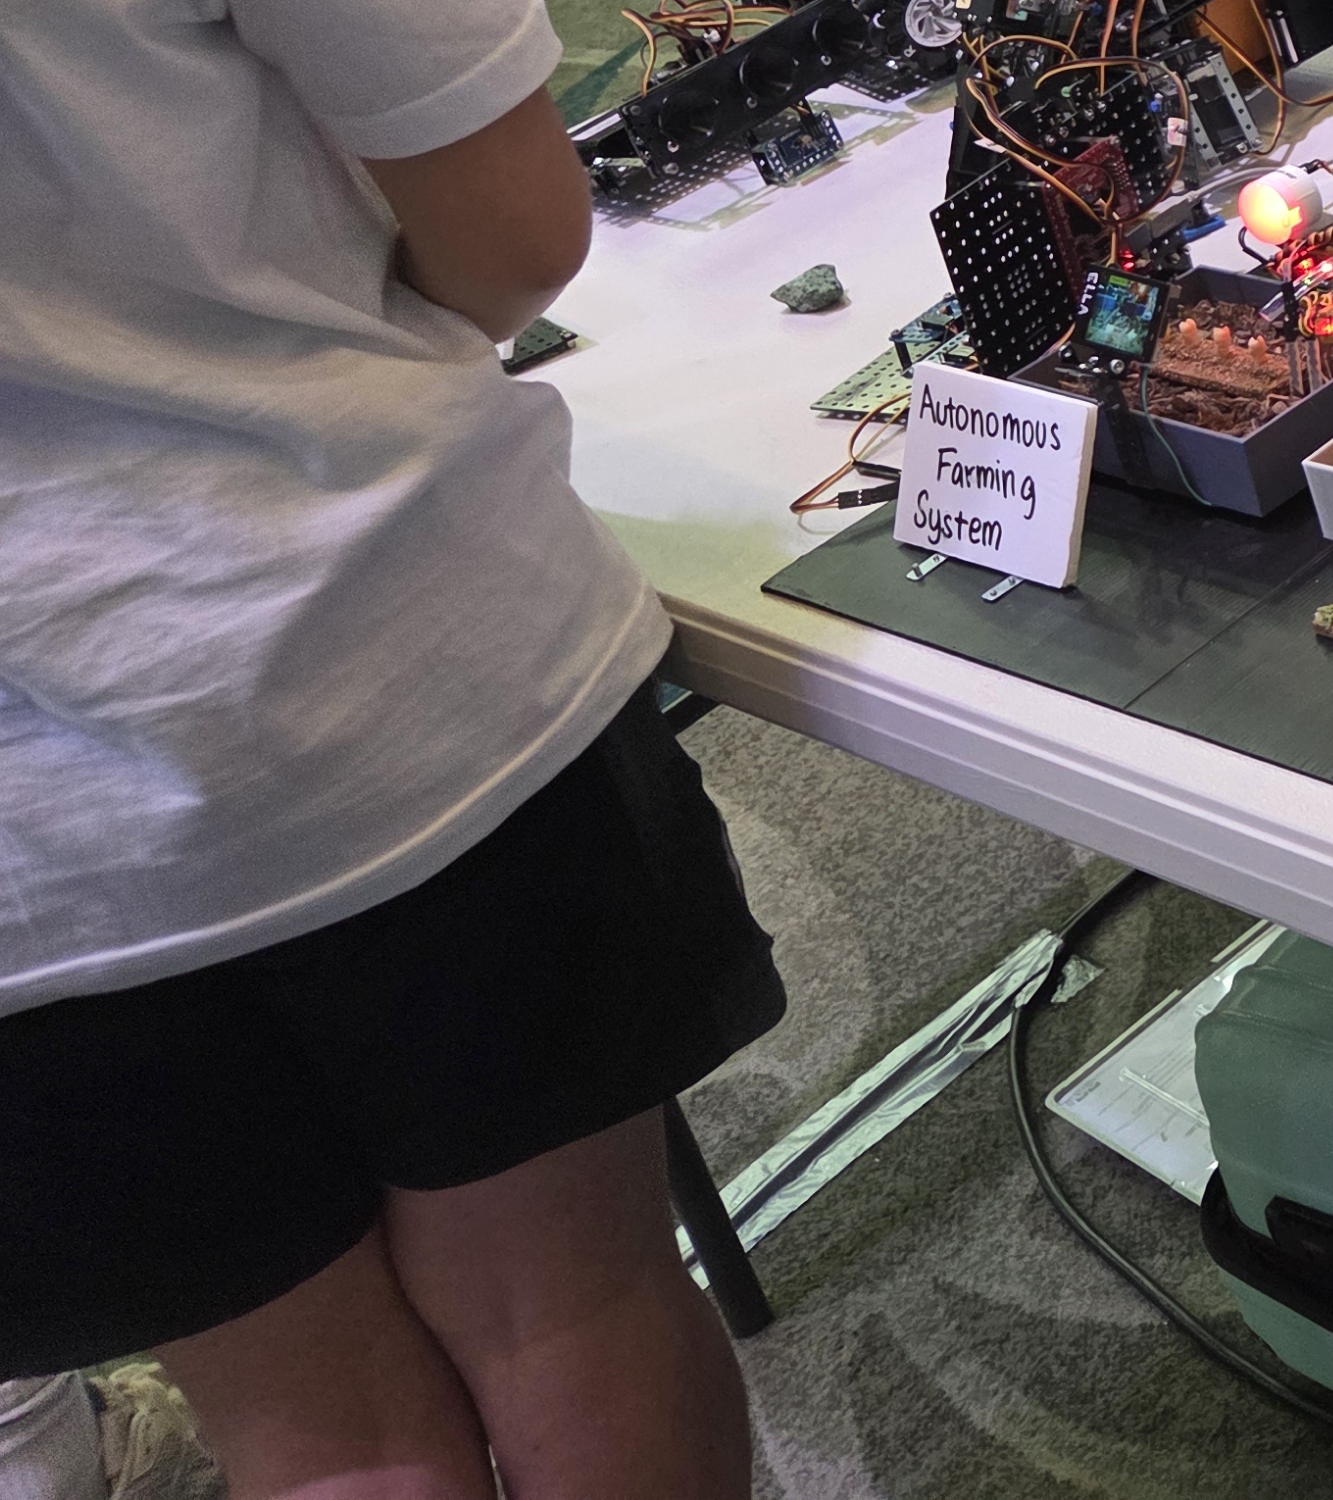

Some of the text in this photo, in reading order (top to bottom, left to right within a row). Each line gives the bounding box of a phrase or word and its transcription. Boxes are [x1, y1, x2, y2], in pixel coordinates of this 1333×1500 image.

[919, 383, 1062, 451] Autonomous
[937, 446, 1036, 521] Farming
[914, 489, 1002, 551] System
